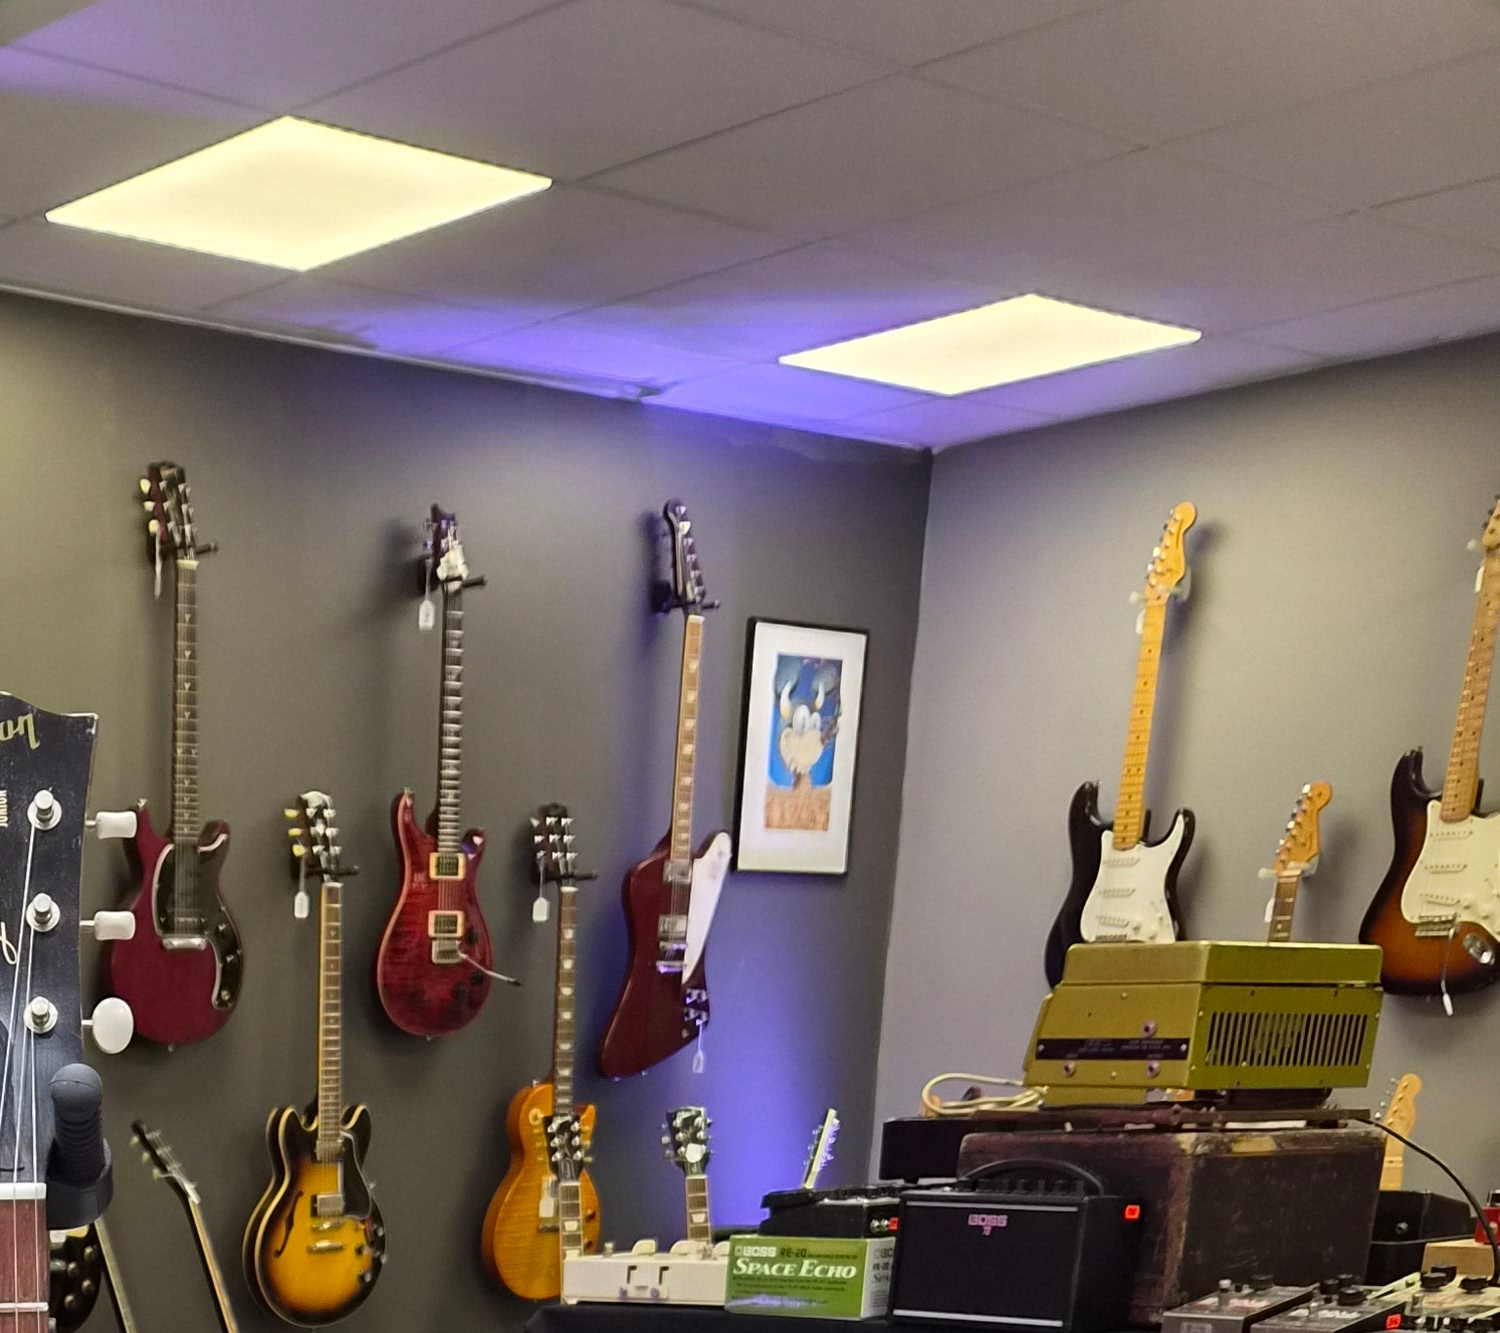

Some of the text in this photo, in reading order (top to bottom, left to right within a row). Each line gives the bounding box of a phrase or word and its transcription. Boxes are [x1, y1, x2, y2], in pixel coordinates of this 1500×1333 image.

[742, 1245, 777, 1258] BOSS
[732, 1257, 797, 1276] SPACE
[798, 1259, 857, 1279] ECHO
